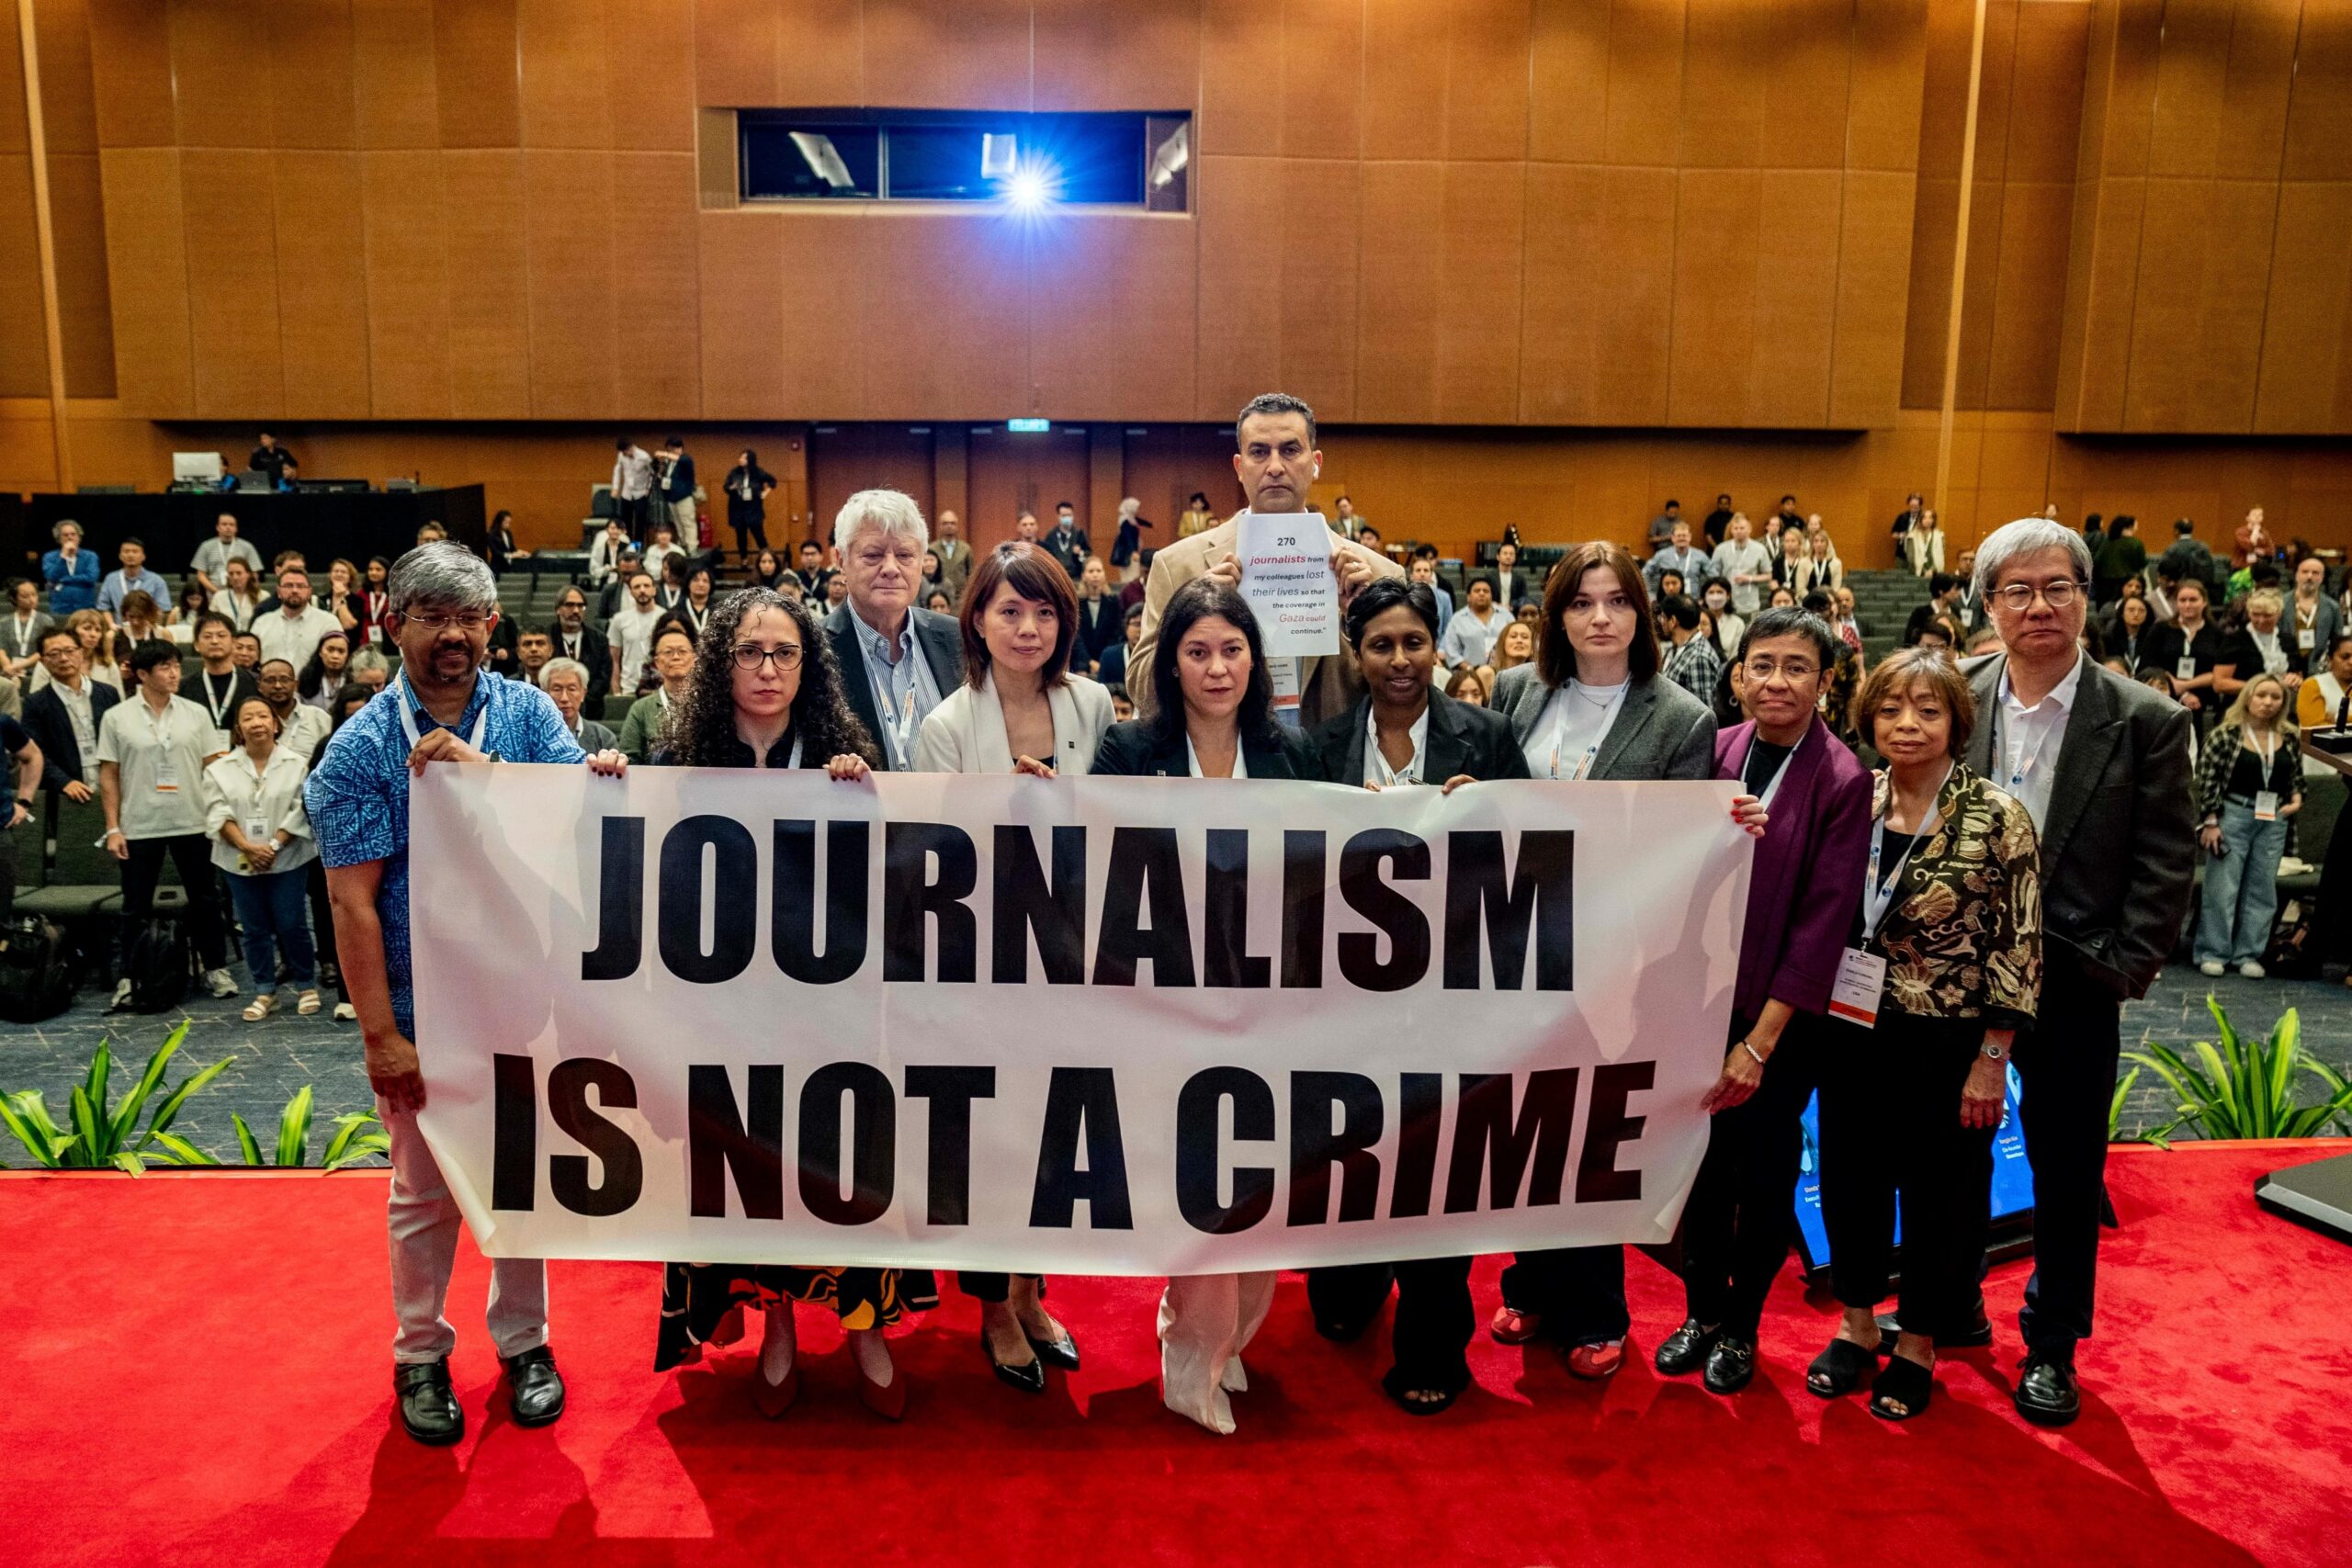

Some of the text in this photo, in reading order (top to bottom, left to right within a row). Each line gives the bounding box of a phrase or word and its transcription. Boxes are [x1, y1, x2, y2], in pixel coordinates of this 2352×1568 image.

[1277, 537, 1295, 546] 270
[1250, 555, 1306, 566] journalists
[1266, 573, 1305, 581] colleagues
[1306, 570, 1324, 579] lost
[1252, 588, 1275, 596] their
[1279, 614, 1305, 623] Gaza
[582, 815, 1575, 991] JOURNALISM
[492, 1054, 1657, 1235] IS NOT A CRIME
